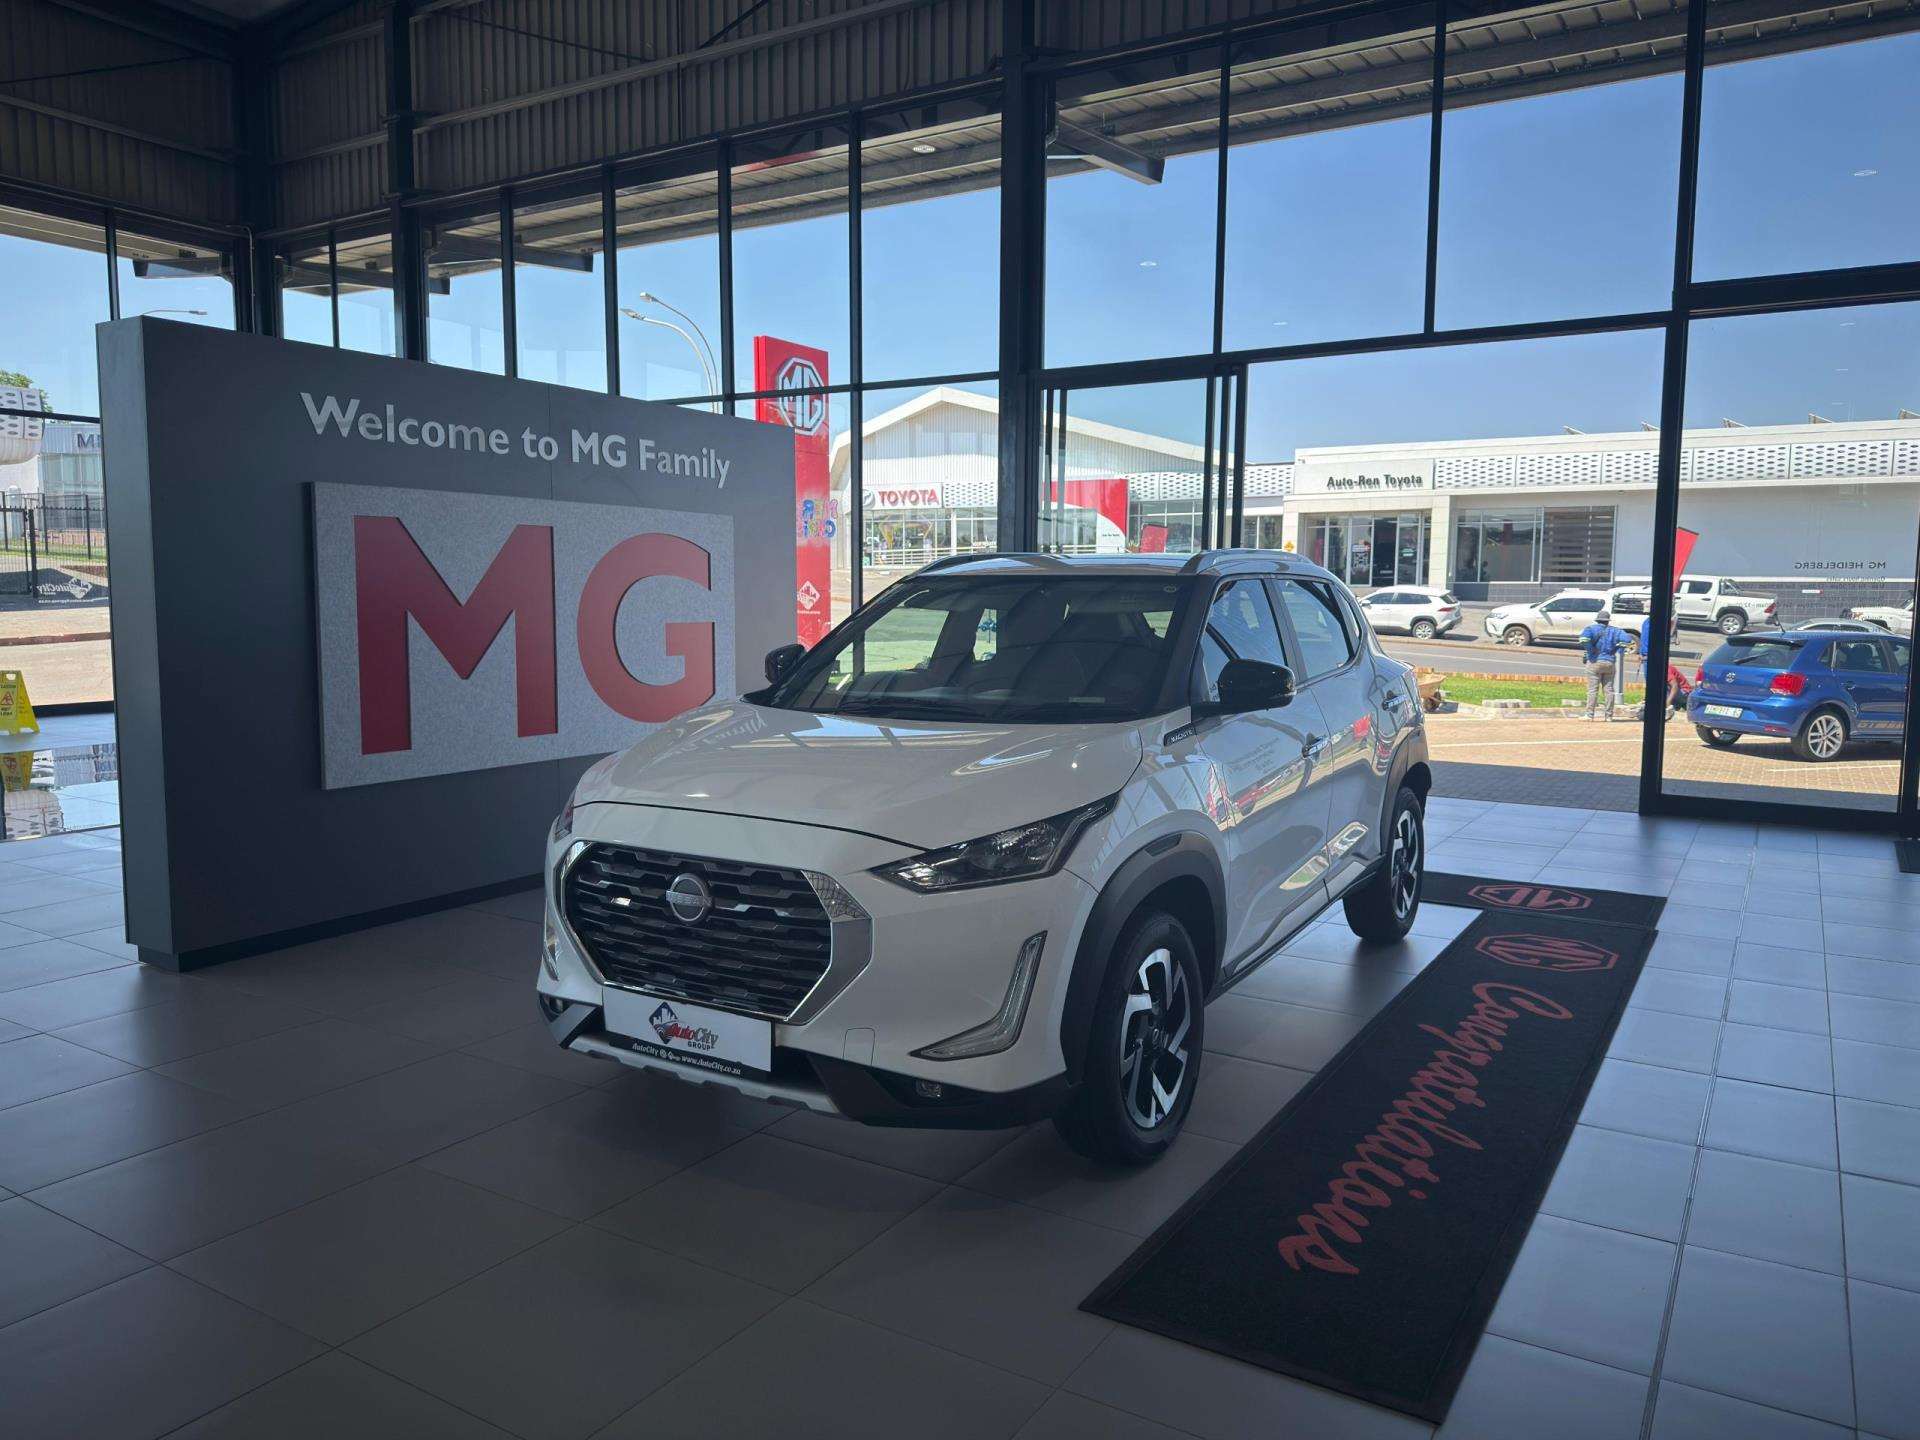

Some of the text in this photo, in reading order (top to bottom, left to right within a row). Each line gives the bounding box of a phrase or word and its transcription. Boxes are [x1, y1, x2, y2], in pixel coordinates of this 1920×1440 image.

[780, 362, 825, 433] MG
[300, 392, 731, 489] Welcome to MG Family
[878, 488, 940, 507] TOYOTA
[1327, 474, 1423, 490] Auto-Ren Toyota
[353, 515, 716, 755] MG
[667, 1022, 720, 1049] AutoCity
[687, 1041, 711, 1051] GROUP
[1277, 982, 1574, 1275] Congratulations
